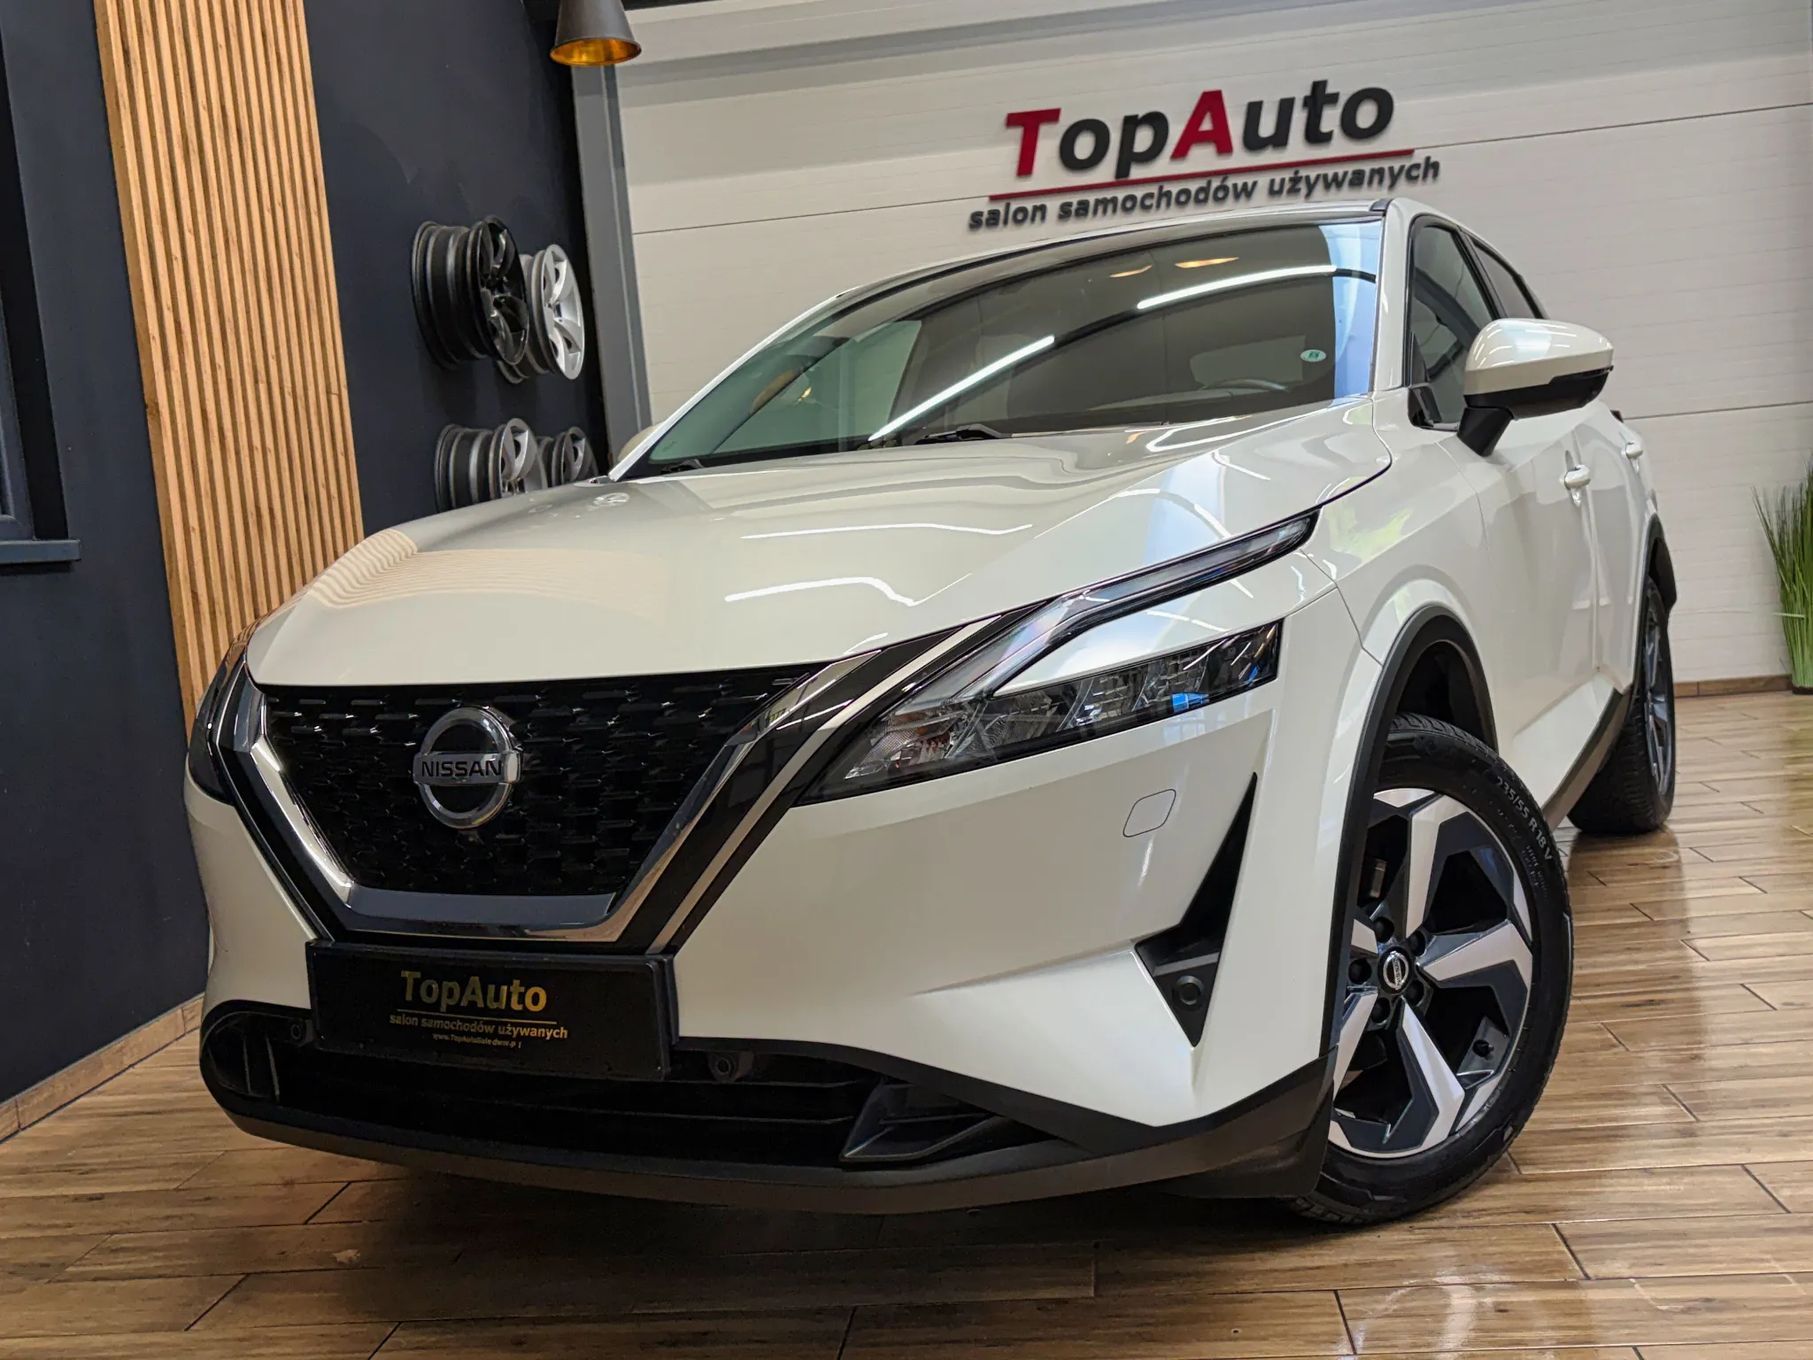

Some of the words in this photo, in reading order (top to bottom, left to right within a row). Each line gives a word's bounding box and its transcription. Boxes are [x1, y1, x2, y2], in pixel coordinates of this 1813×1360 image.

[1006, 79, 1394, 179] TopAuto
[969, 202, 1047, 229] salon
[1058, 177, 1257, 220] samochodów
[1268, 156, 1440, 199] używanych
[421, 760, 502, 777] NISSAN
[401, 970, 547, 1012] TopAuto
[389, 1013, 419, 1026] salon
[421, 1016, 496, 1034] samochodów
[498, 1024, 568, 1041] używanych
